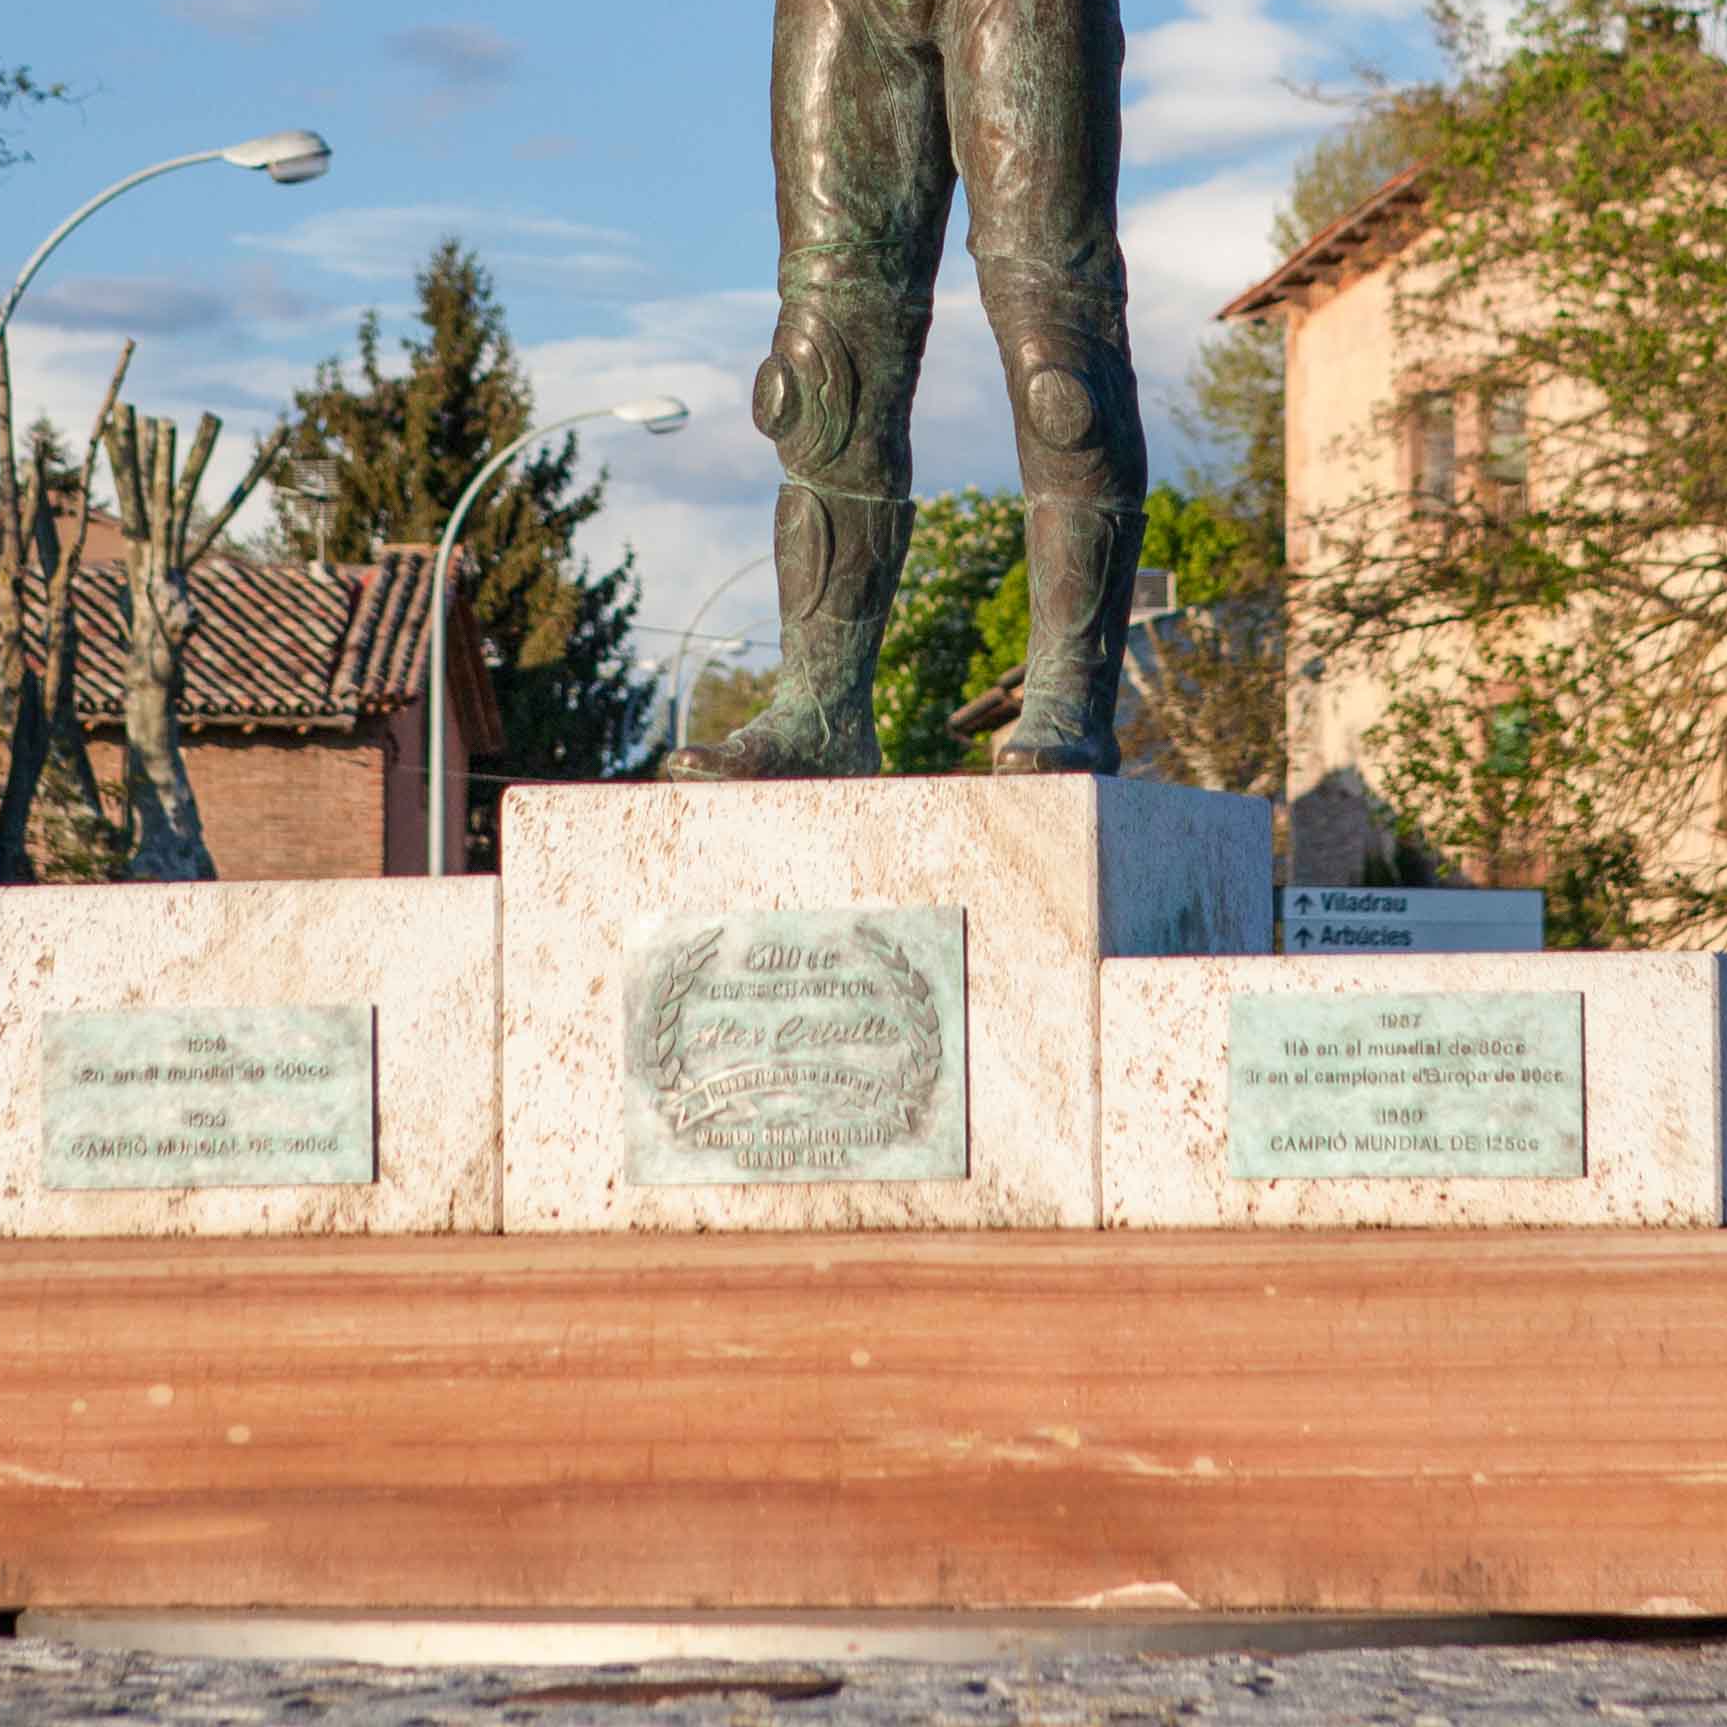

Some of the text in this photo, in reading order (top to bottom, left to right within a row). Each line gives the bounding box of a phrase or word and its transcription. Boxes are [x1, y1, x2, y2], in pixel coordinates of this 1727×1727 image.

[1319, 891, 1409, 913] Viladrau
[1318, 924, 1417, 947] Arbúcies
[771, 978, 876, 1000] CHAMPION
[1379, 1012, 1423, 1030] 1987
[1315, 1042, 1339, 1057] en
[1345, 1039, 1362, 1057] el
[1367, 1039, 1442, 1057] mundial
[1447, 1039, 1472, 1057] de
[167, 1062, 235, 1083] mundial
[273, 1059, 332, 1080] 500cc
[1267, 1071, 1289, 1086] en
[1294, 1068, 1309, 1086] el
[1314, 1068, 1407, 1088] campionat
[1411, 1067, 1488, 1088] d'Europa
[1493, 1067, 1516, 1084] de
[156, 1135, 240, 1157] MUNDIAL
[695, 1127, 755, 1148] WORLD
[1269, 1129, 1541, 1153] CAMPIÓ MUNDIAL DE 125cc
